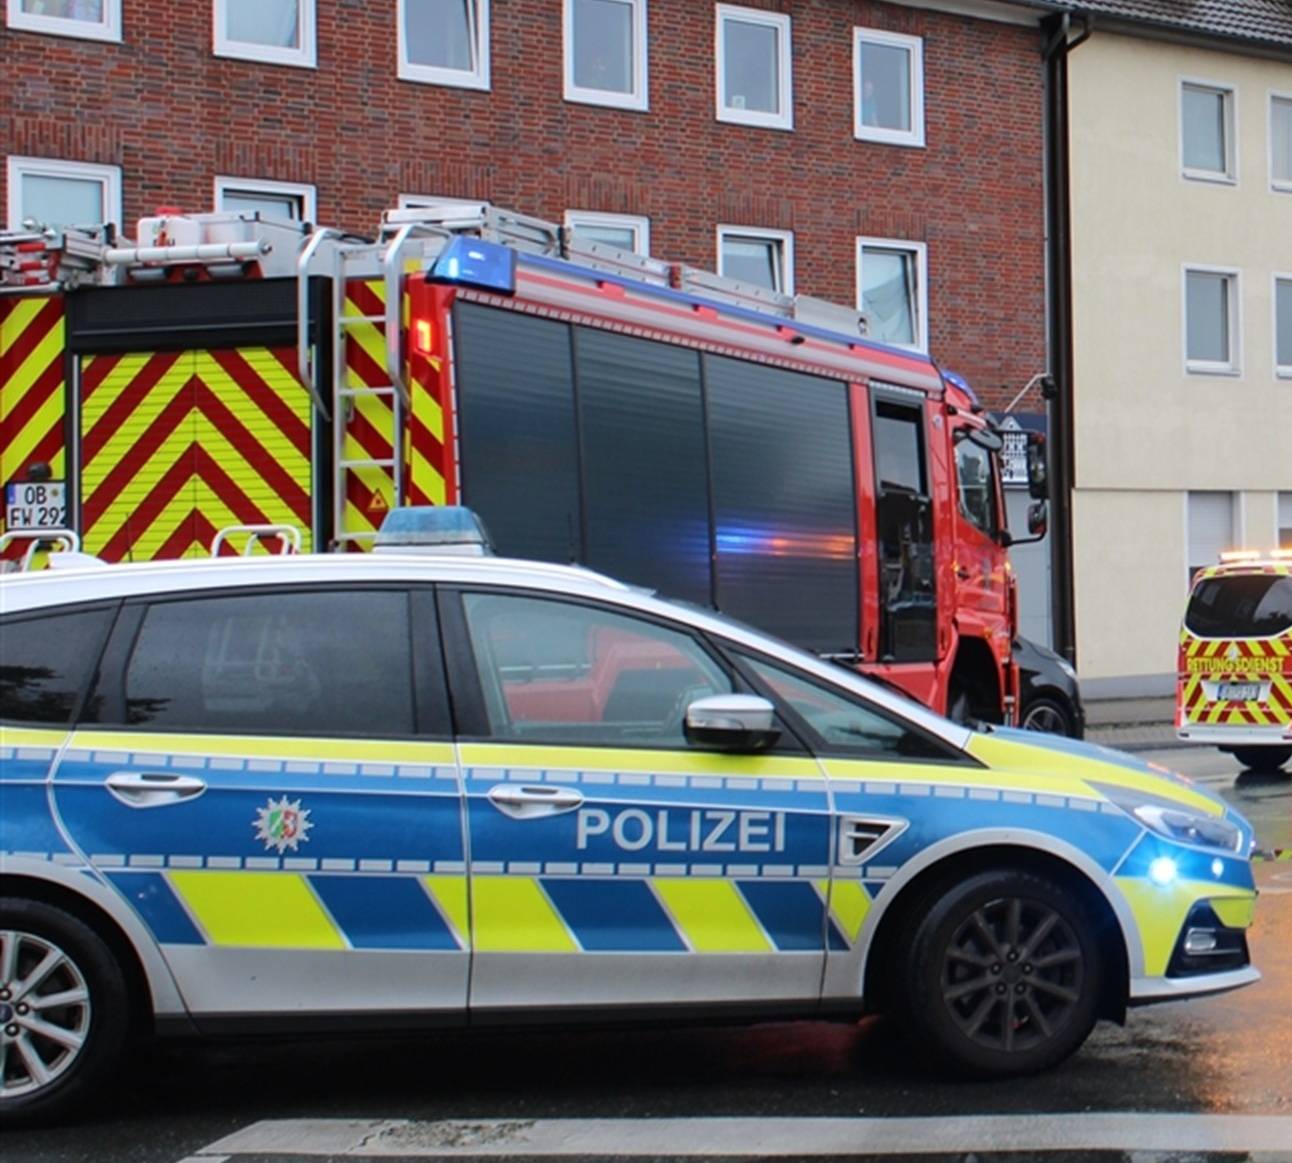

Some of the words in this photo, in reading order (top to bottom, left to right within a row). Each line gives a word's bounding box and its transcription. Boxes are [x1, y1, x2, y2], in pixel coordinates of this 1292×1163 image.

[25, 485, 47, 505] OB
[10, 507, 33, 526] FW
[38, 506, 66, 526] 292
[1186, 656, 1285, 674] RETTUNGSDIENST
[576, 808, 786, 852] POLIZEI
